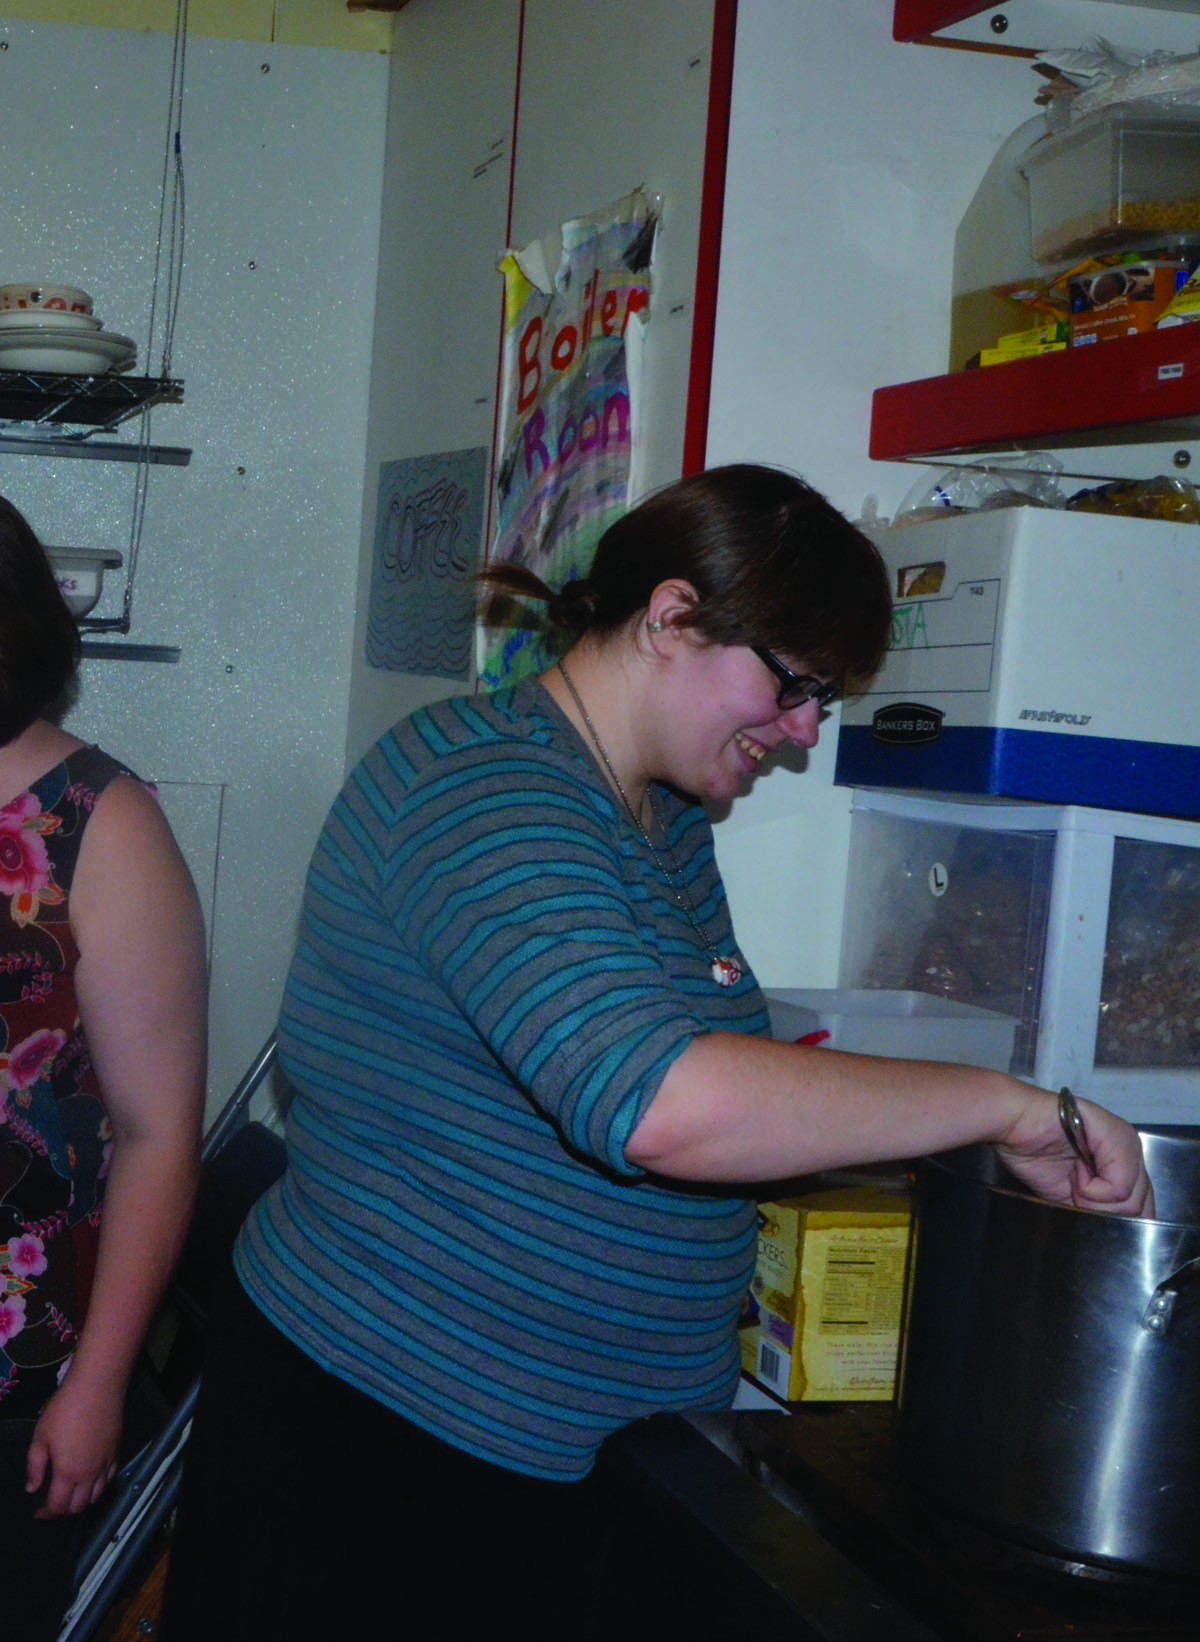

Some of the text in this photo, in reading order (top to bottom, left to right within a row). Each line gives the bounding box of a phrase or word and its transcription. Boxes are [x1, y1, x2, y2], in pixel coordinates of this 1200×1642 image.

[517, 268, 650, 415] Boiler
[875, 719, 936, 732] BANKERS BOX
[933, 867, 944, 888] L
